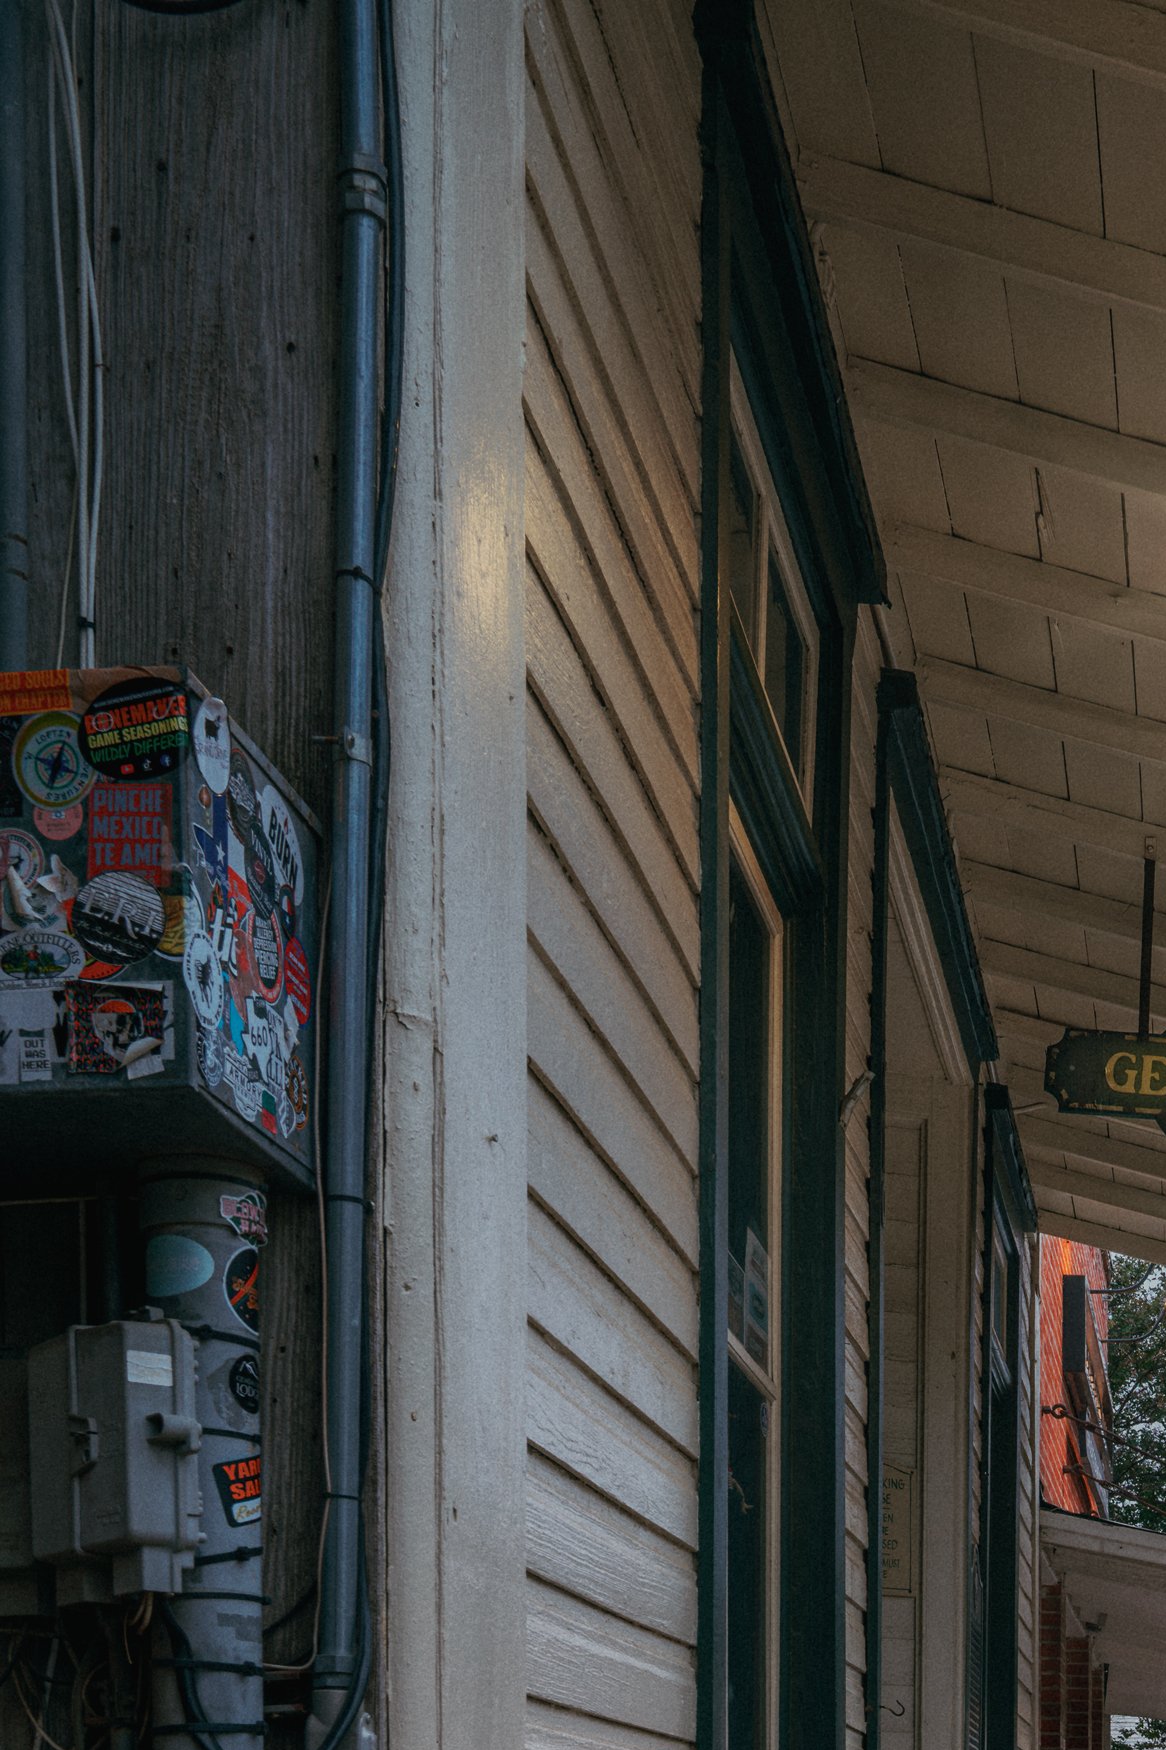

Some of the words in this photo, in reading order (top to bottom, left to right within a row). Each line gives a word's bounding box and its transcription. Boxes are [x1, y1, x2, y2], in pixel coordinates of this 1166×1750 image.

[87, 729, 122, 749] GAME
[90, 742, 131, 763] WILDLY
[93, 789, 165, 812] PINCHE
[93, 842, 116, 866] TE
[268, 806, 298, 890] BURN
[23, 932, 81, 966] OUTFITTERS
[23, 1038, 46, 1049] OUT
[24, 1049, 47, 1059] WAS
[21, 1059, 51, 1070] HERE
